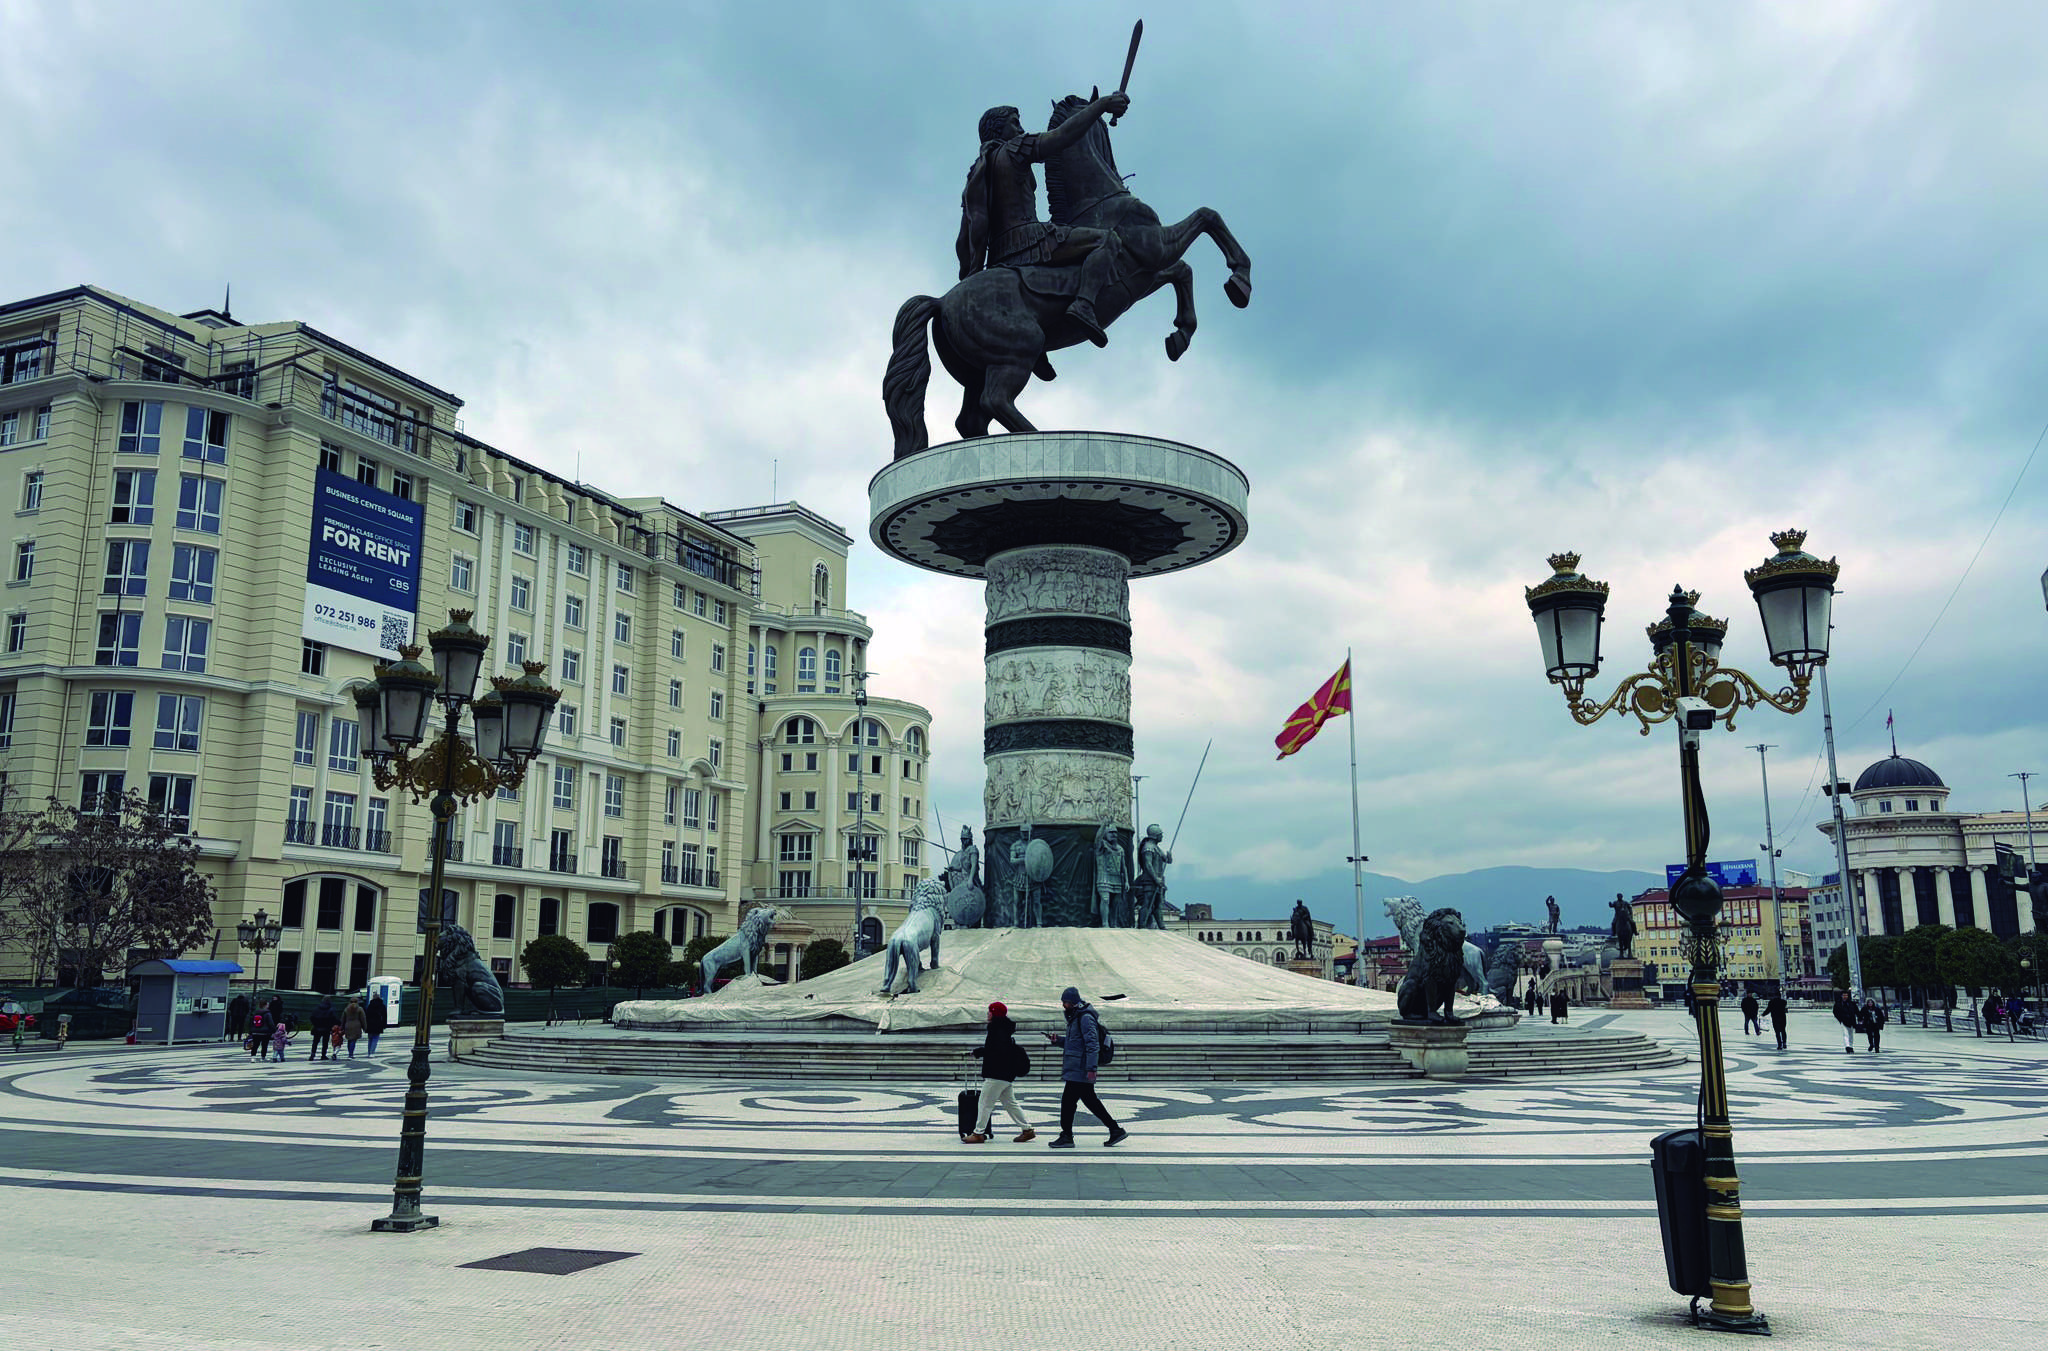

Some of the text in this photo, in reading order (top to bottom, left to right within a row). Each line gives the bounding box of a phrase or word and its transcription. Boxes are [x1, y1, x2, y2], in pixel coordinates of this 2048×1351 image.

[326, 486, 413, 524] BUSINESS CENTER SQUARE
[322, 524, 410, 568] FOR RENT
[324, 516, 350, 530] PREMIUM
[356, 528, 374, 538] CLASS
[374, 534, 393, 546] OFFICE
[394, 540, 410, 550] SPACE
[318, 563, 374, 584] LEASING AGENT
[320, 555, 358, 572] EXCLUSIVE
[389, 578, 410, 590] CBS
[314, 604, 376, 630] 072 251 986
